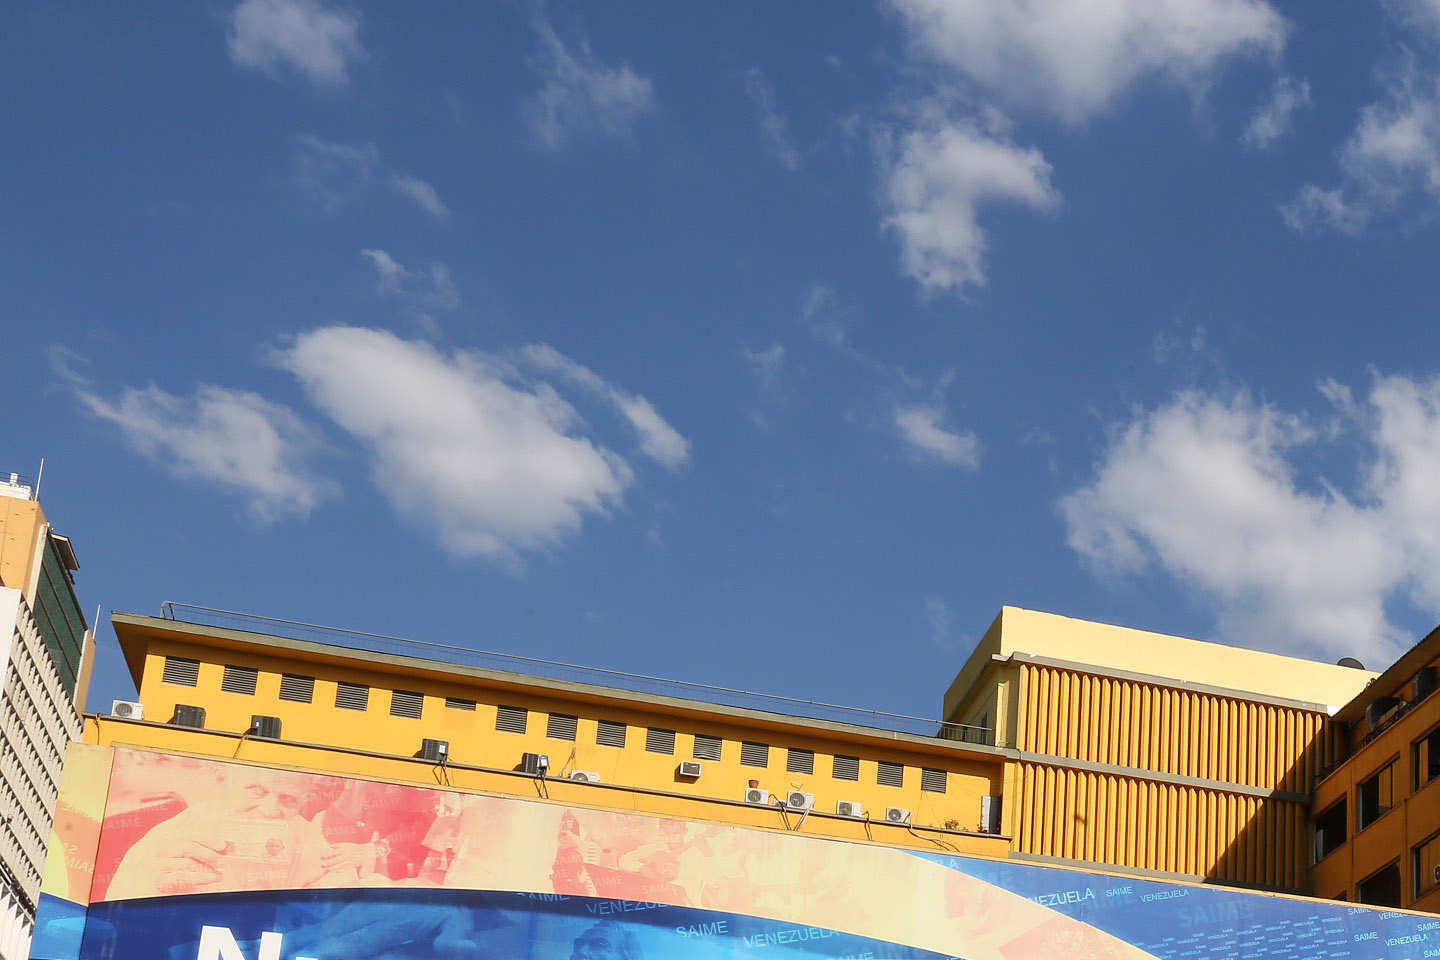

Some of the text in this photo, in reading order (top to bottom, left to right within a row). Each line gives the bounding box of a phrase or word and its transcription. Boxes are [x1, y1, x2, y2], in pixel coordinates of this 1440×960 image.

[1106, 886, 1133, 898] SAIME
[1140, 888, 1189, 903] VENEZUELA
[676, 920, 728, 938] SAIME
[1417, 921, 1440, 932] SAIME
[743, 925, 841, 949] VENEZUELA
[1354, 931, 1378, 942] SAIME
[1384, 933, 1428, 947] VENEZUELA
